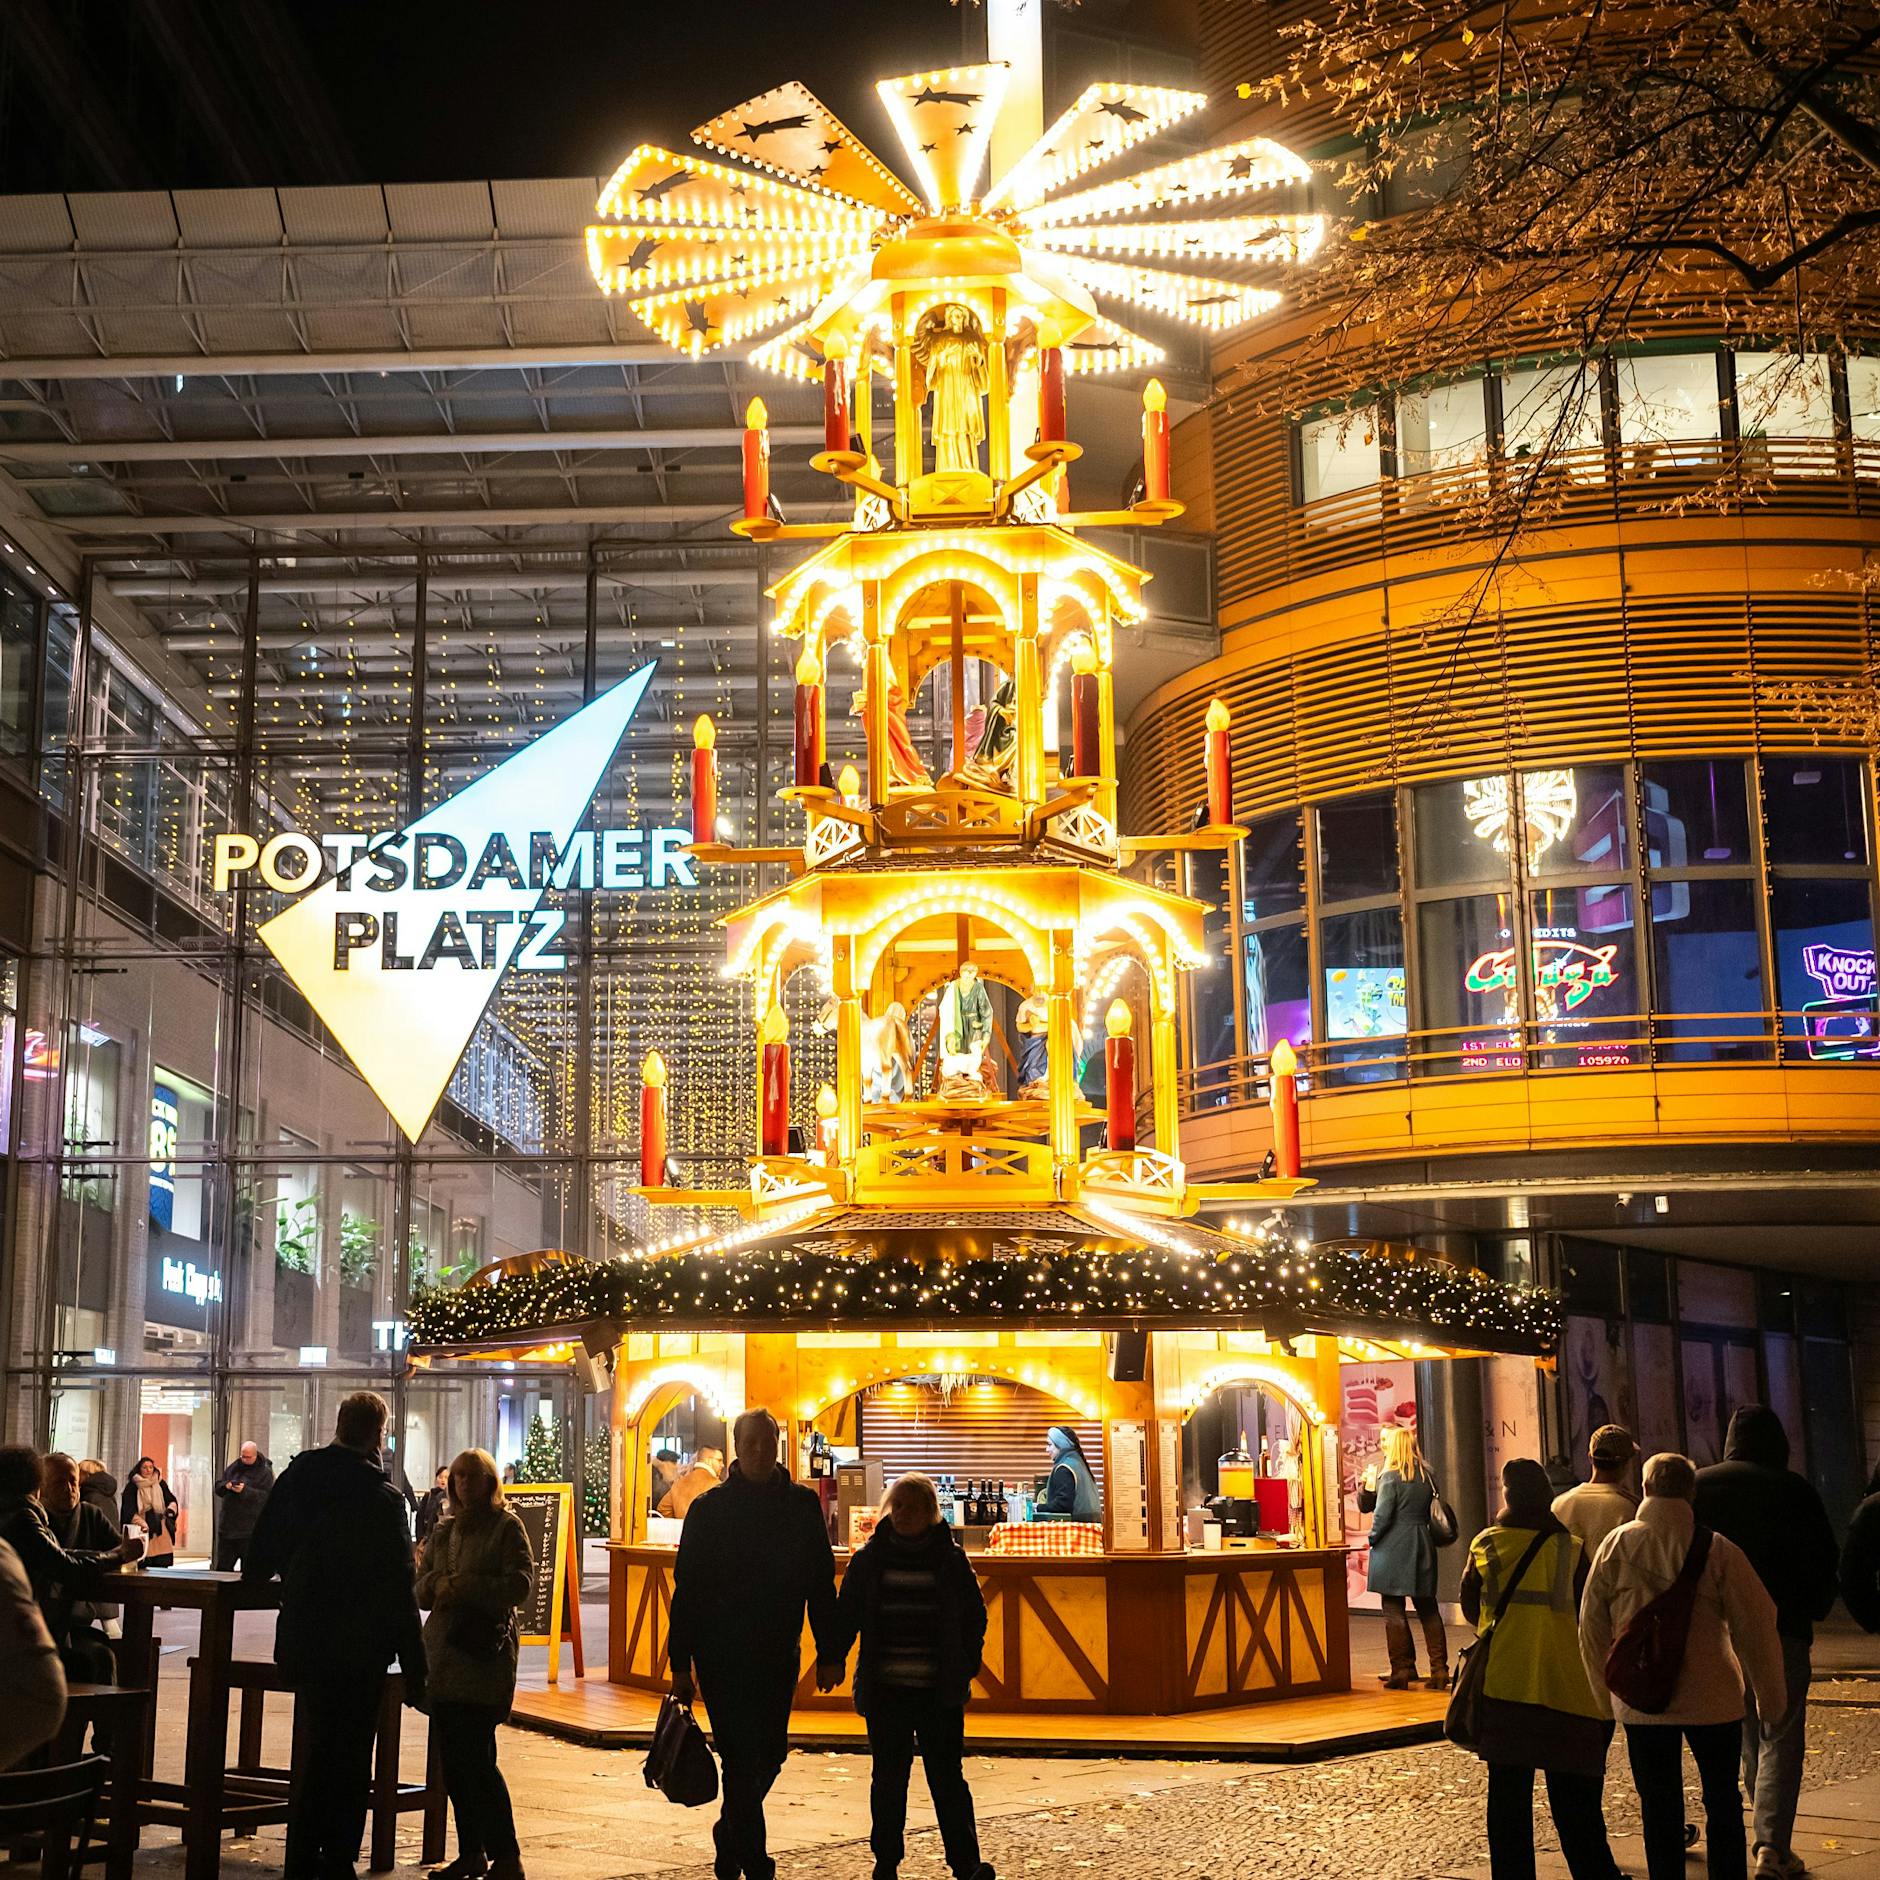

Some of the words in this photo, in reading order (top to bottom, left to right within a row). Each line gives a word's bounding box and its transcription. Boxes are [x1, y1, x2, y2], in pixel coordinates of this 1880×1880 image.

[213, 828, 698, 893] POTSDAMER
[332, 910, 567, 971] PLATZ
[1817, 952, 1877, 975] KNOCK
[1832, 971, 1872, 993] OUT
[1462, 1056, 1488, 1067] 2ND
[1496, 1056, 1521, 1067] ELO
[1578, 1055, 1630, 1067] 105970
[1501, 1420, 1517, 1438] N
